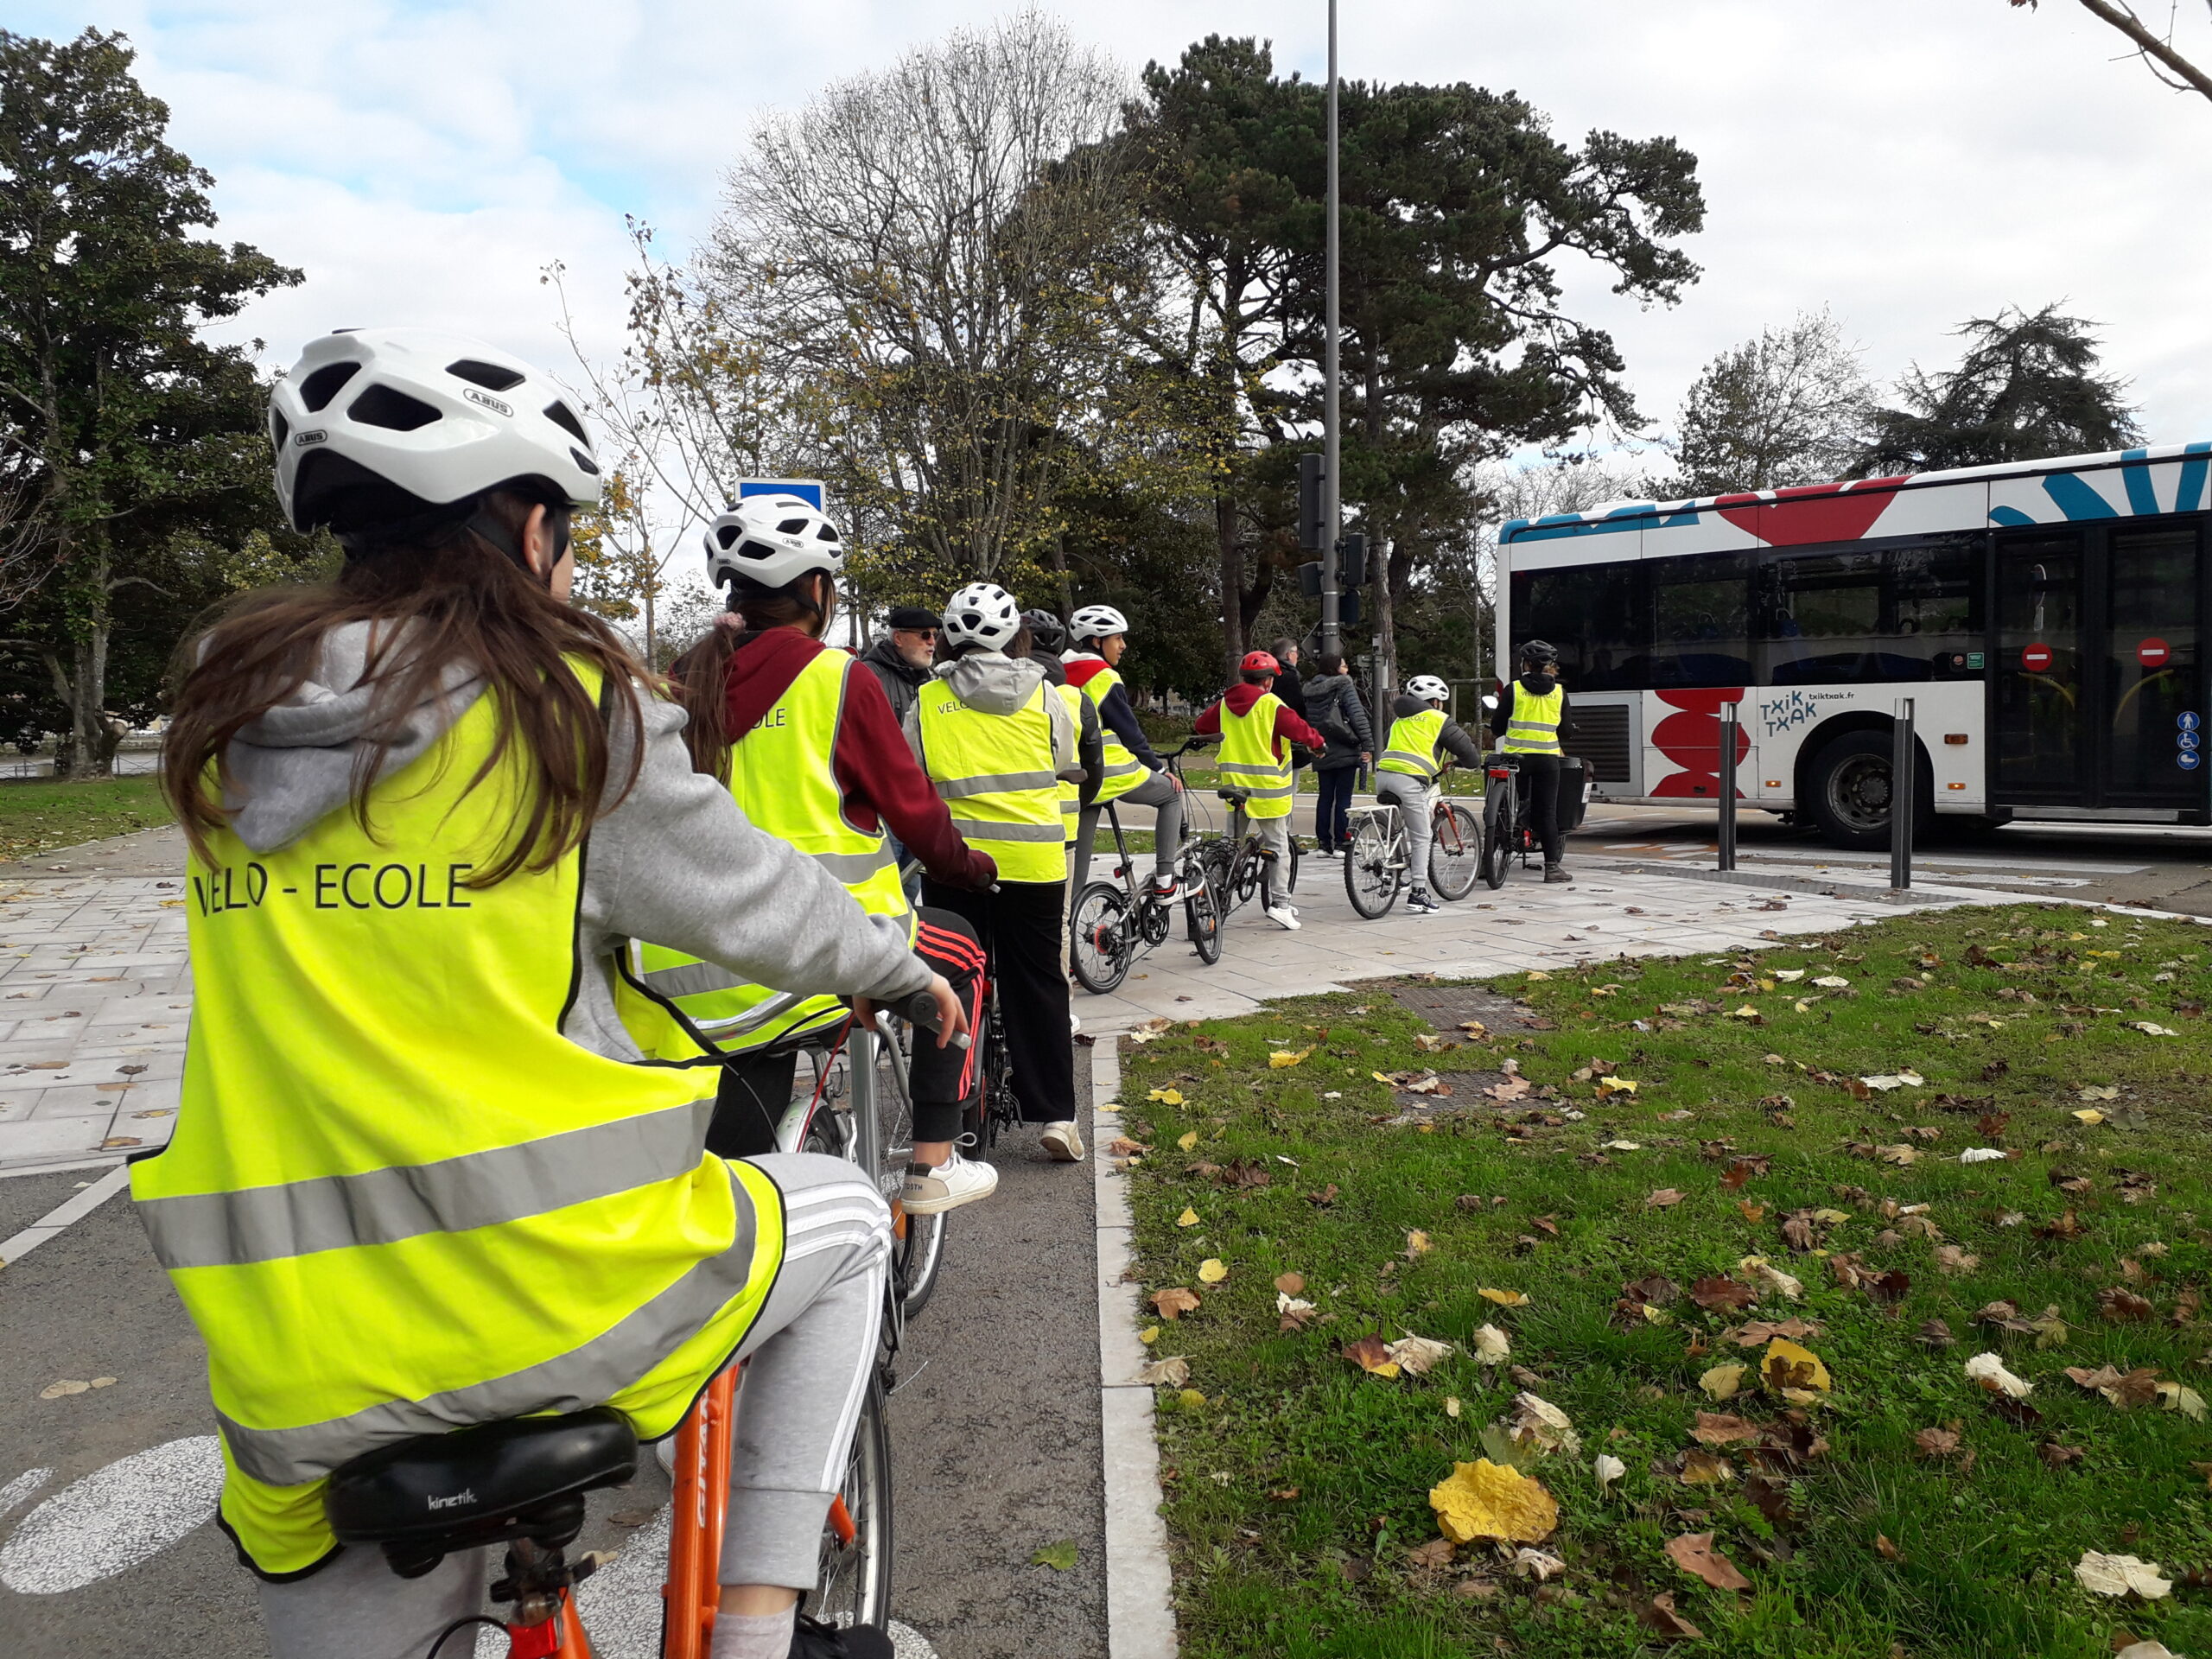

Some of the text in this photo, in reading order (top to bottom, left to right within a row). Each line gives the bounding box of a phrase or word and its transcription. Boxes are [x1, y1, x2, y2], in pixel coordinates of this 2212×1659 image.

[470, 392, 508, 414] ABUS
[298, 432, 323, 443] ABUS
[1808, 692, 1855, 701] txiktxak.fr
[1765, 702, 1817, 737] TXAK
[193, 861, 268, 918] VELO
[315, 863, 473, 909] ECOLE
[428, 1488, 478, 1510] kinetik
